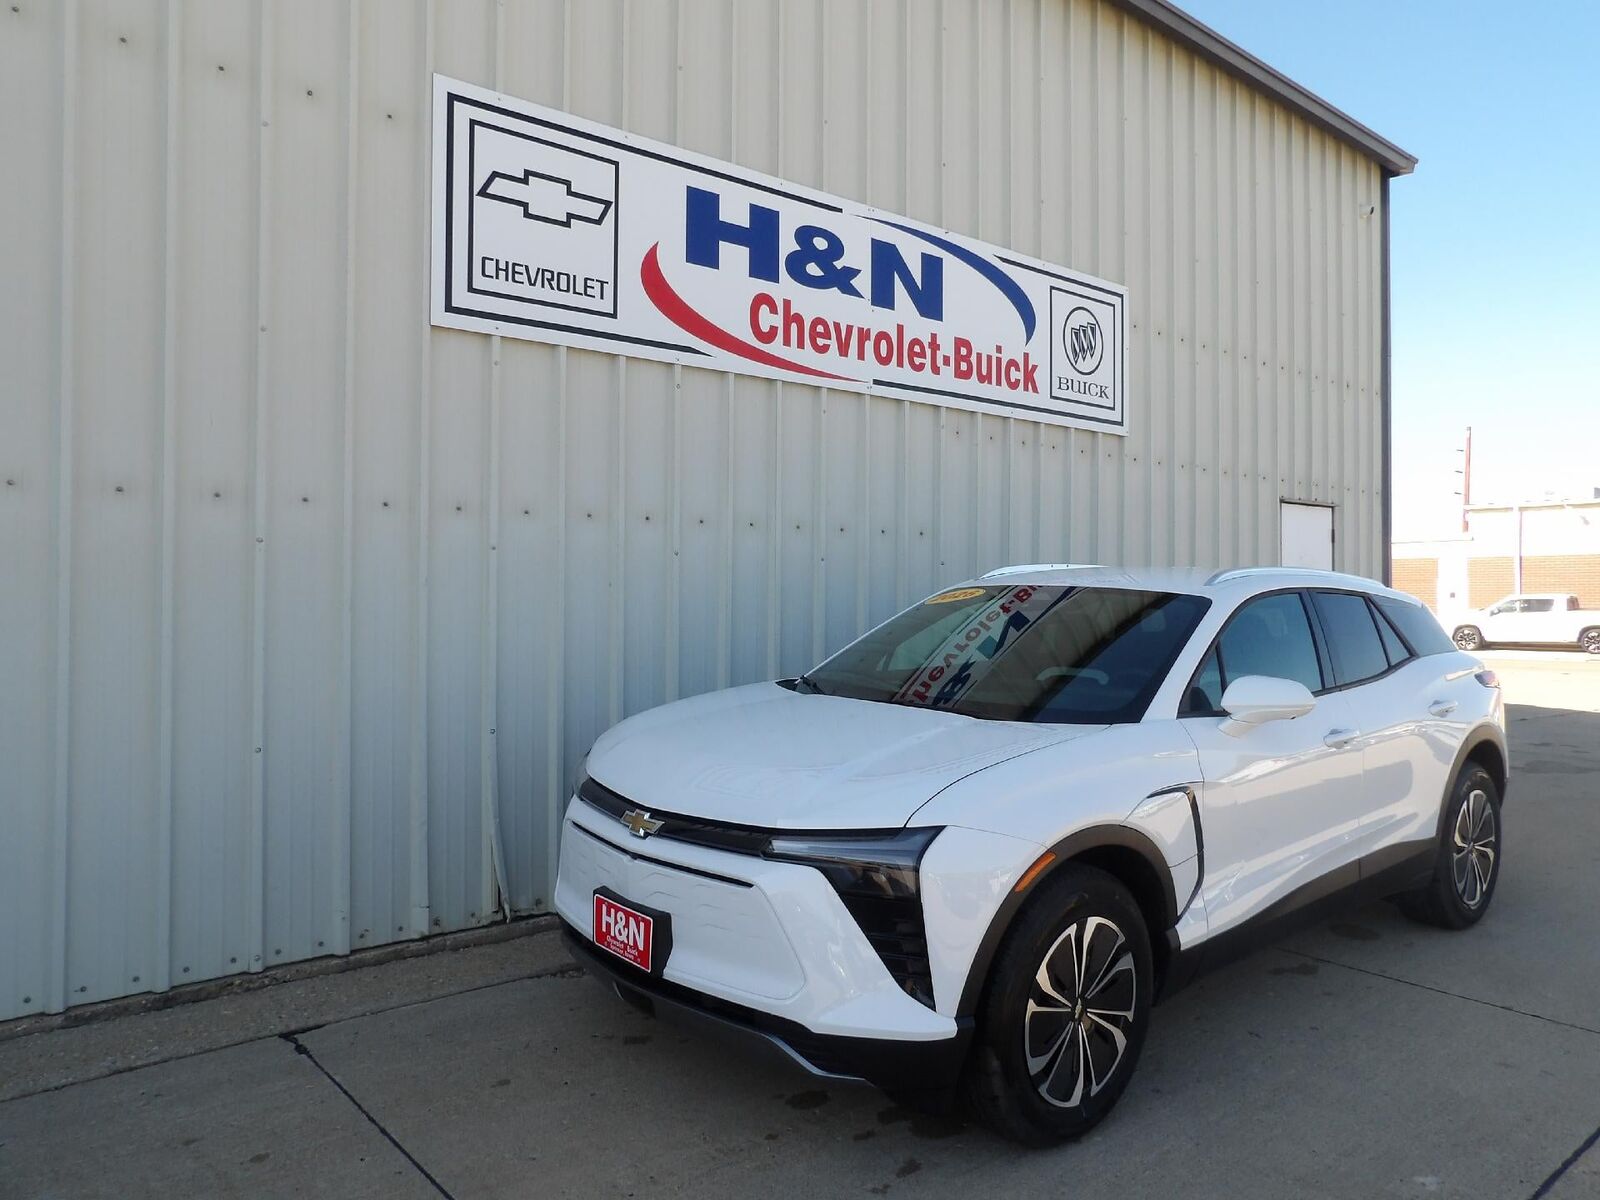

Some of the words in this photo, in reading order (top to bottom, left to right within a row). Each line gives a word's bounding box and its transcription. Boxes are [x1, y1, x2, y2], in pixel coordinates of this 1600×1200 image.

[686, 184, 944, 322] H&N
[481, 255, 609, 300] CHEVROLET
[1057, 376, 1110, 399] BUICK
[601, 903, 645, 951] H&N
